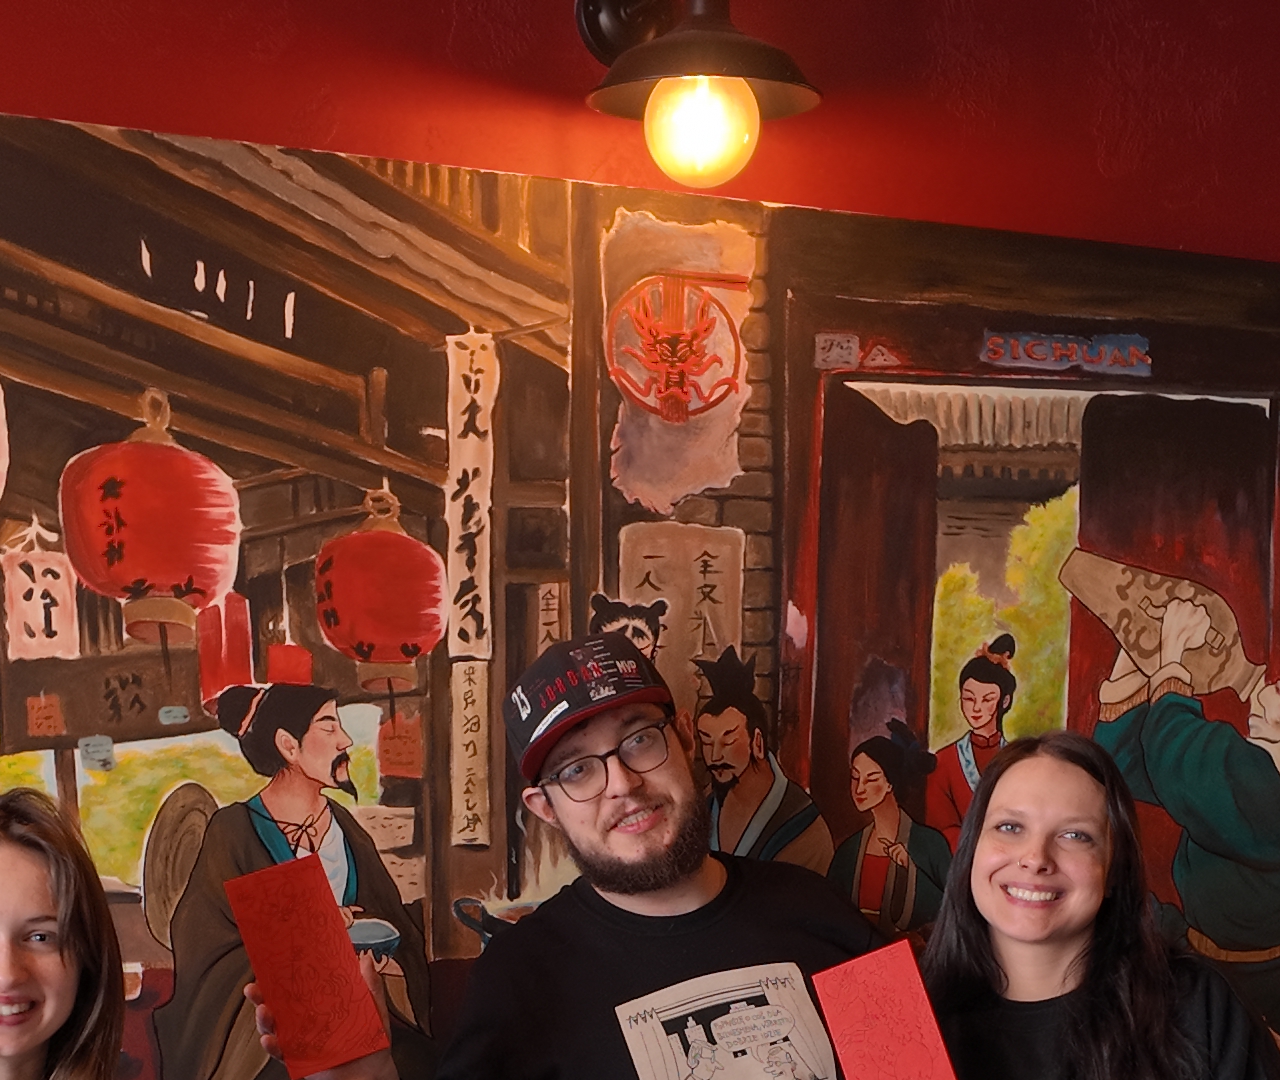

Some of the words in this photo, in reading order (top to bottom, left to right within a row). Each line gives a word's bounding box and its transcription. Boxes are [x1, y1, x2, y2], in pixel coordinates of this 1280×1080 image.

[986, 335, 1153, 368] SICHUAN
[615, 660, 638, 675] MVP
[539, 661, 603, 710] JORDAN
[511, 685, 532, 721] 23
